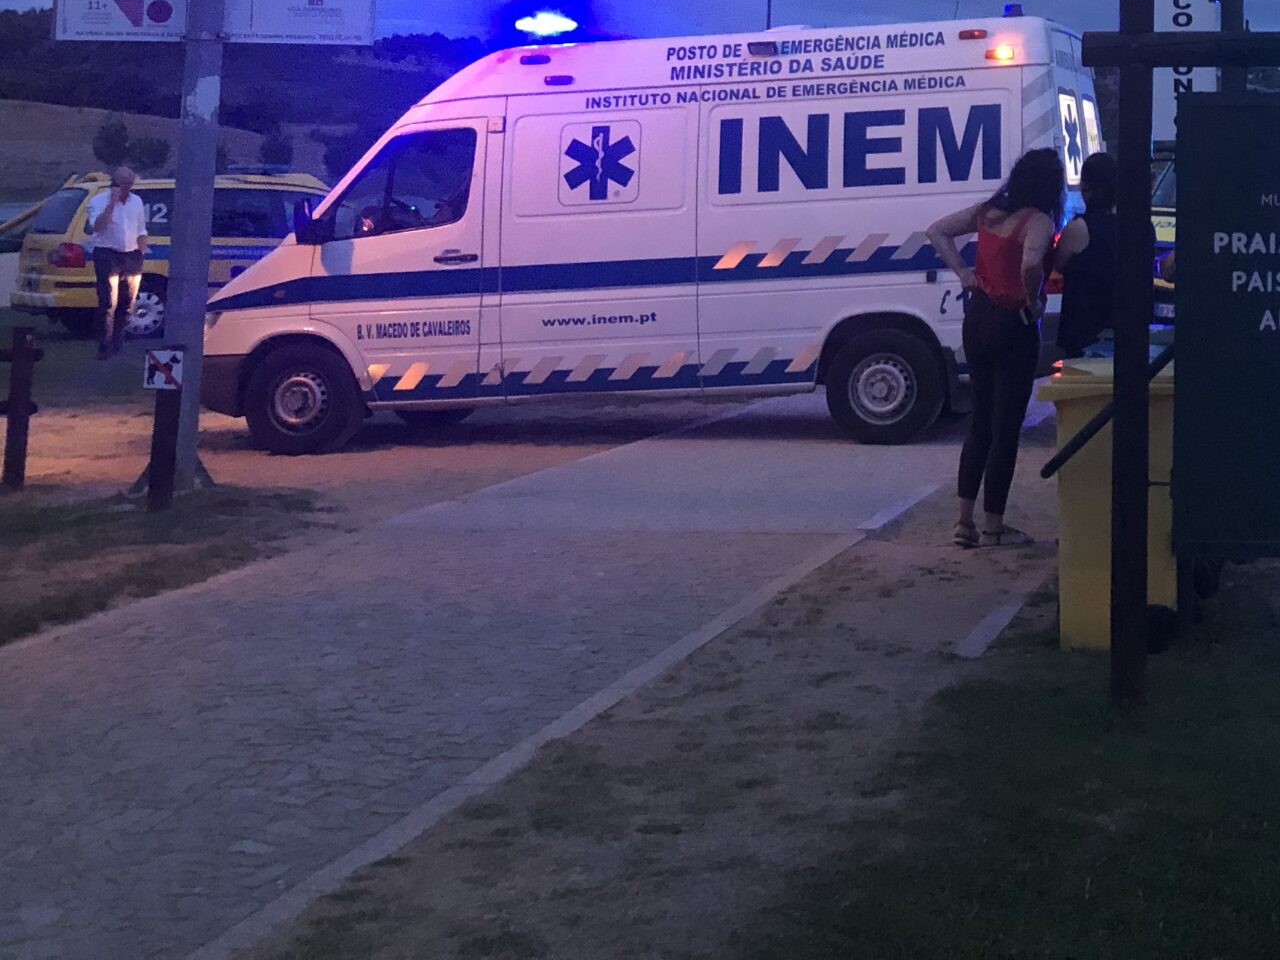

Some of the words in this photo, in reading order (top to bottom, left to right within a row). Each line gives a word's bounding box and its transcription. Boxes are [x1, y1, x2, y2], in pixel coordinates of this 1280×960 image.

[666, 45, 717, 61] POSTO
[722, 44, 742, 58] DE
[781, 35, 881, 54] EMERGÊNCIA
[886, 31, 945, 49] MÉDICA
[670, 58, 782, 81] MINISTÉRIO
[789, 58, 814, 74] DA
[821, 52, 885, 72] SAÚDE
[585, 93, 671, 109] INSTITUTO
[677, 88, 760, 103] NACIONAL
[766, 86, 787, 98] DE
[792, 79, 898, 97] EMERGÊNCIA
[904, 74, 966, 90] MÉDICA
[718, 104, 1002, 194] INEM
[366, 324, 374, 339] V.
[376, 322, 408, 339] MACEDO
[411, 322, 420, 337] DE
[423, 320, 471, 337] CAVALEIROS
[542, 312, 657, 326] www.inem.pt
